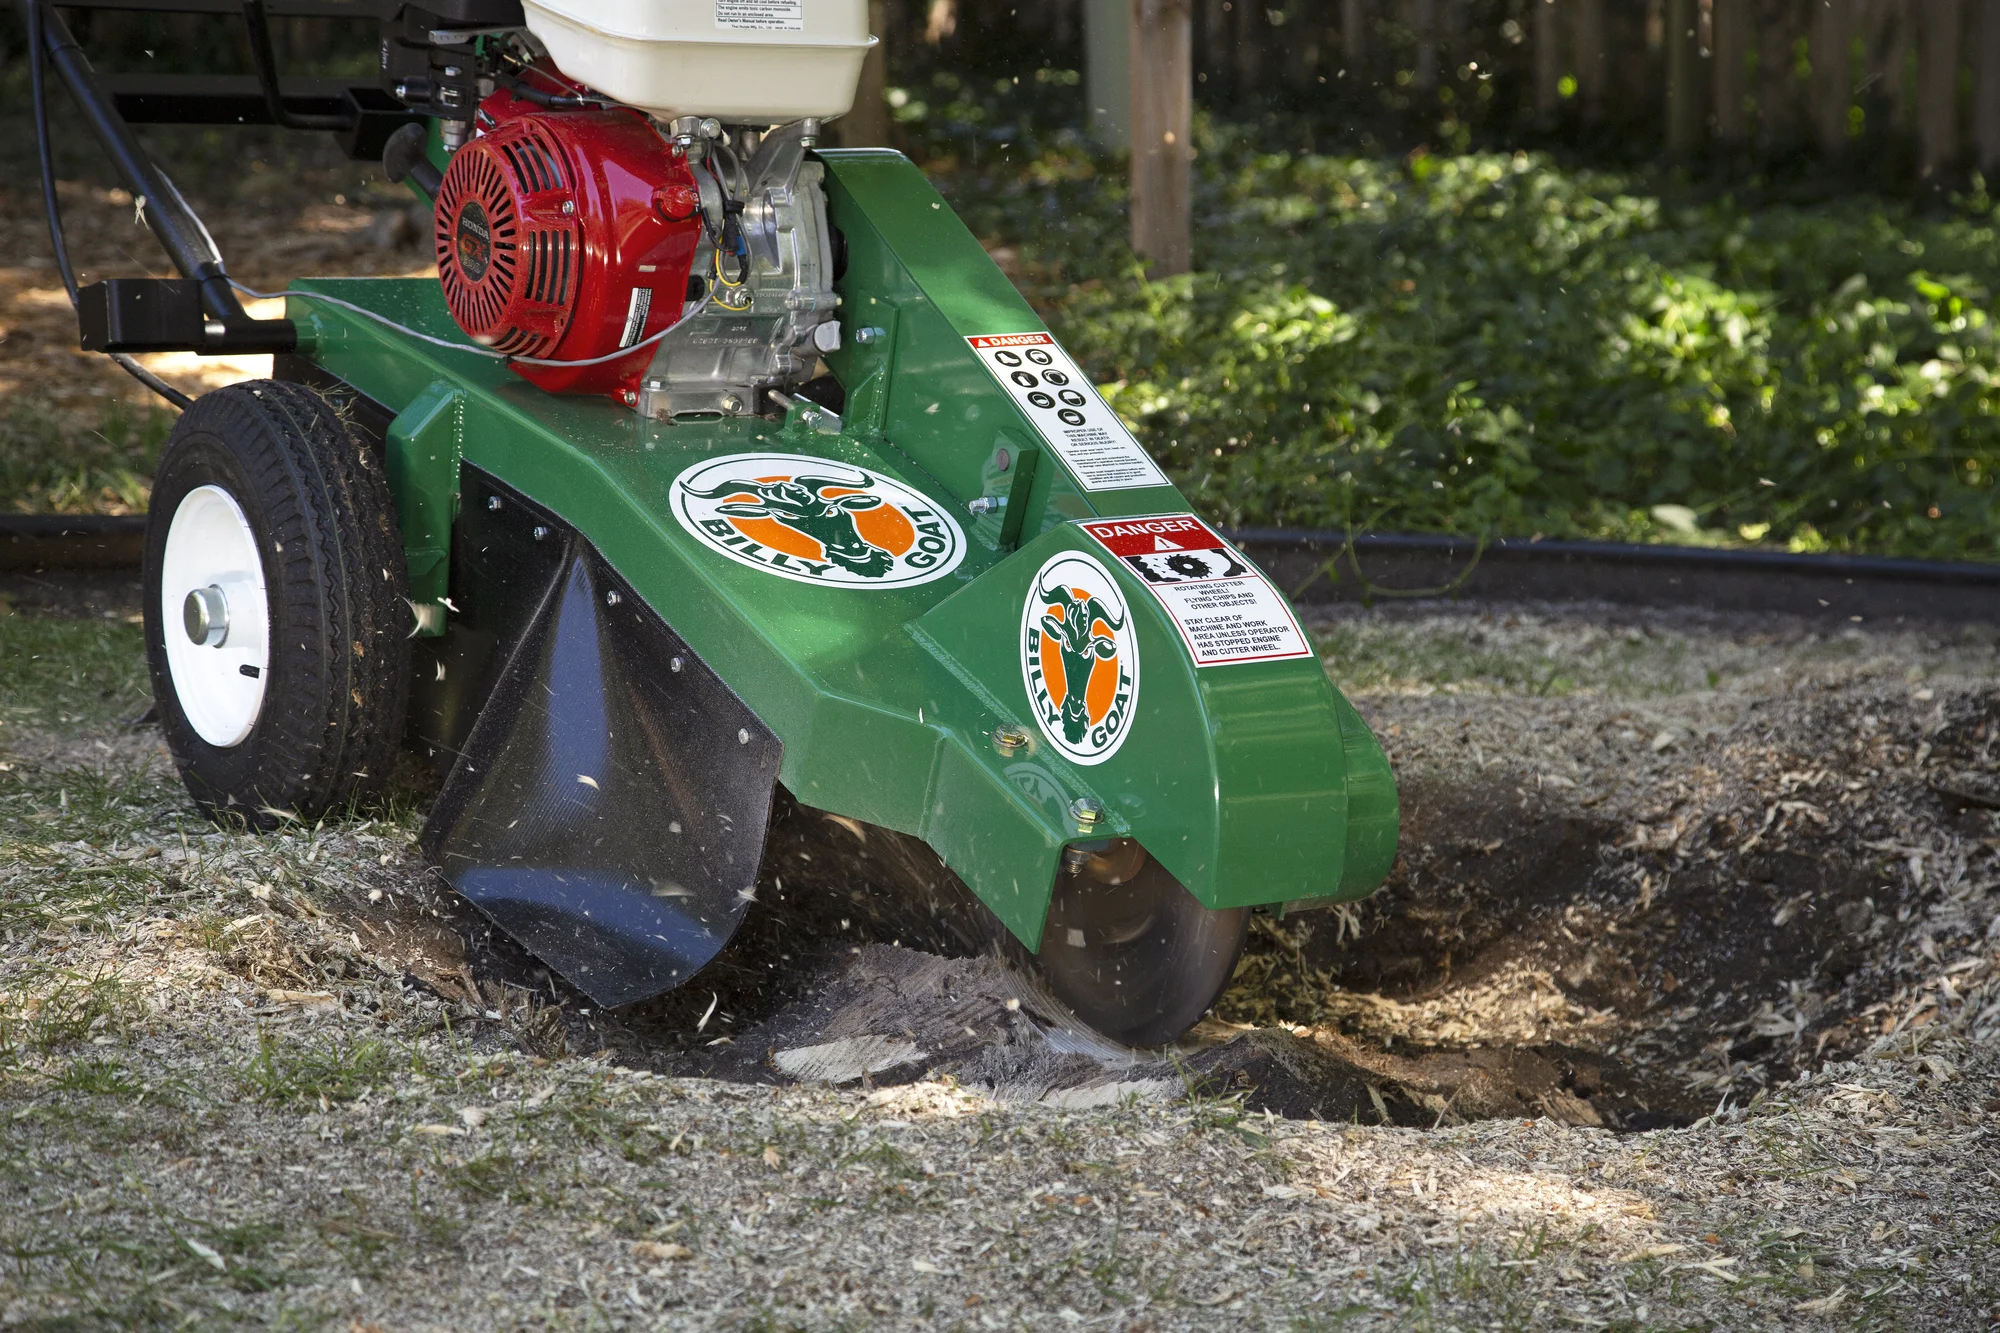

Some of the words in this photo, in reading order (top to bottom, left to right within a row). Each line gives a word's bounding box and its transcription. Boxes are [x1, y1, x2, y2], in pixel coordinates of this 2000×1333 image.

[462, 216, 490, 240] HONDA
[461, 233, 487, 262] GX
[989, 335, 1048, 346] DANGER
[1093, 520, 1200, 538] DANGER
[699, 518, 836, 577] BILLY
[905, 506, 948, 569] GOAT
[1174, 583, 1213, 591] ROTATING
[1191, 601, 1219, 610] OTHER
[1220, 598, 1257, 608] OBJECTS!
[1188, 624, 1225, 633] MACHINE
[1242, 620, 1268, 628] WORK
[1193, 632, 1215, 640] AREA
[1216, 629, 1247, 639] UNLESS
[1248, 625, 1290, 635] OPERATOR
[1215, 637, 1251, 647] STOPPED
[1252, 635, 1282, 643] ENGINE
[1219, 646, 1250, 655] CUTTER
[1251, 643, 1281, 652] WHEEL.
[1029, 627, 1061, 726] BILLY
[1092, 665, 1131, 748] GOAT
